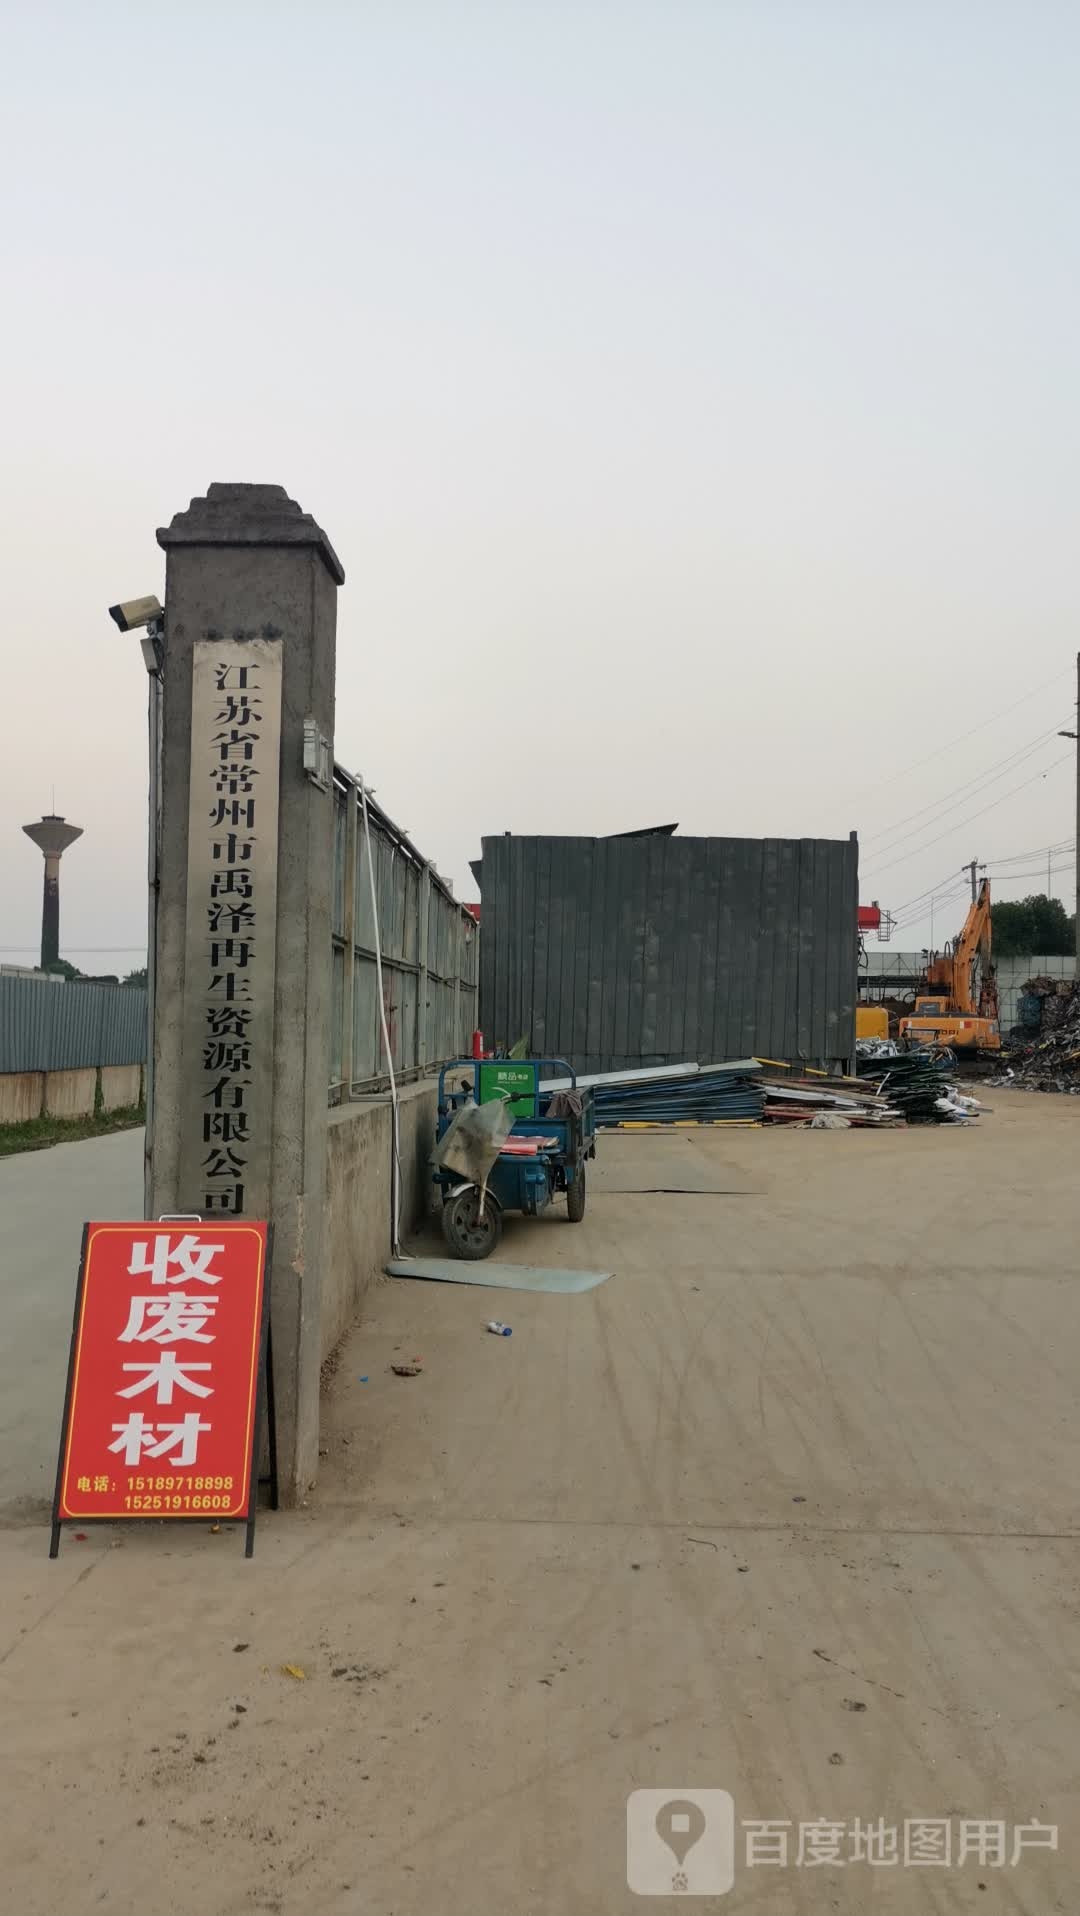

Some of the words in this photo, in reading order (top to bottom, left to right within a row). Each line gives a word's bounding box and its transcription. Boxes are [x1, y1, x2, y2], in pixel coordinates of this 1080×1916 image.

[201, 662, 263, 1214] 江苏省常州市禹泽再生资源有限公司
[107, 1234, 225, 1467] 收废木材
[124, 1495, 231, 1510] 15251916608
[127, 1476, 233, 1491] 15189718898
